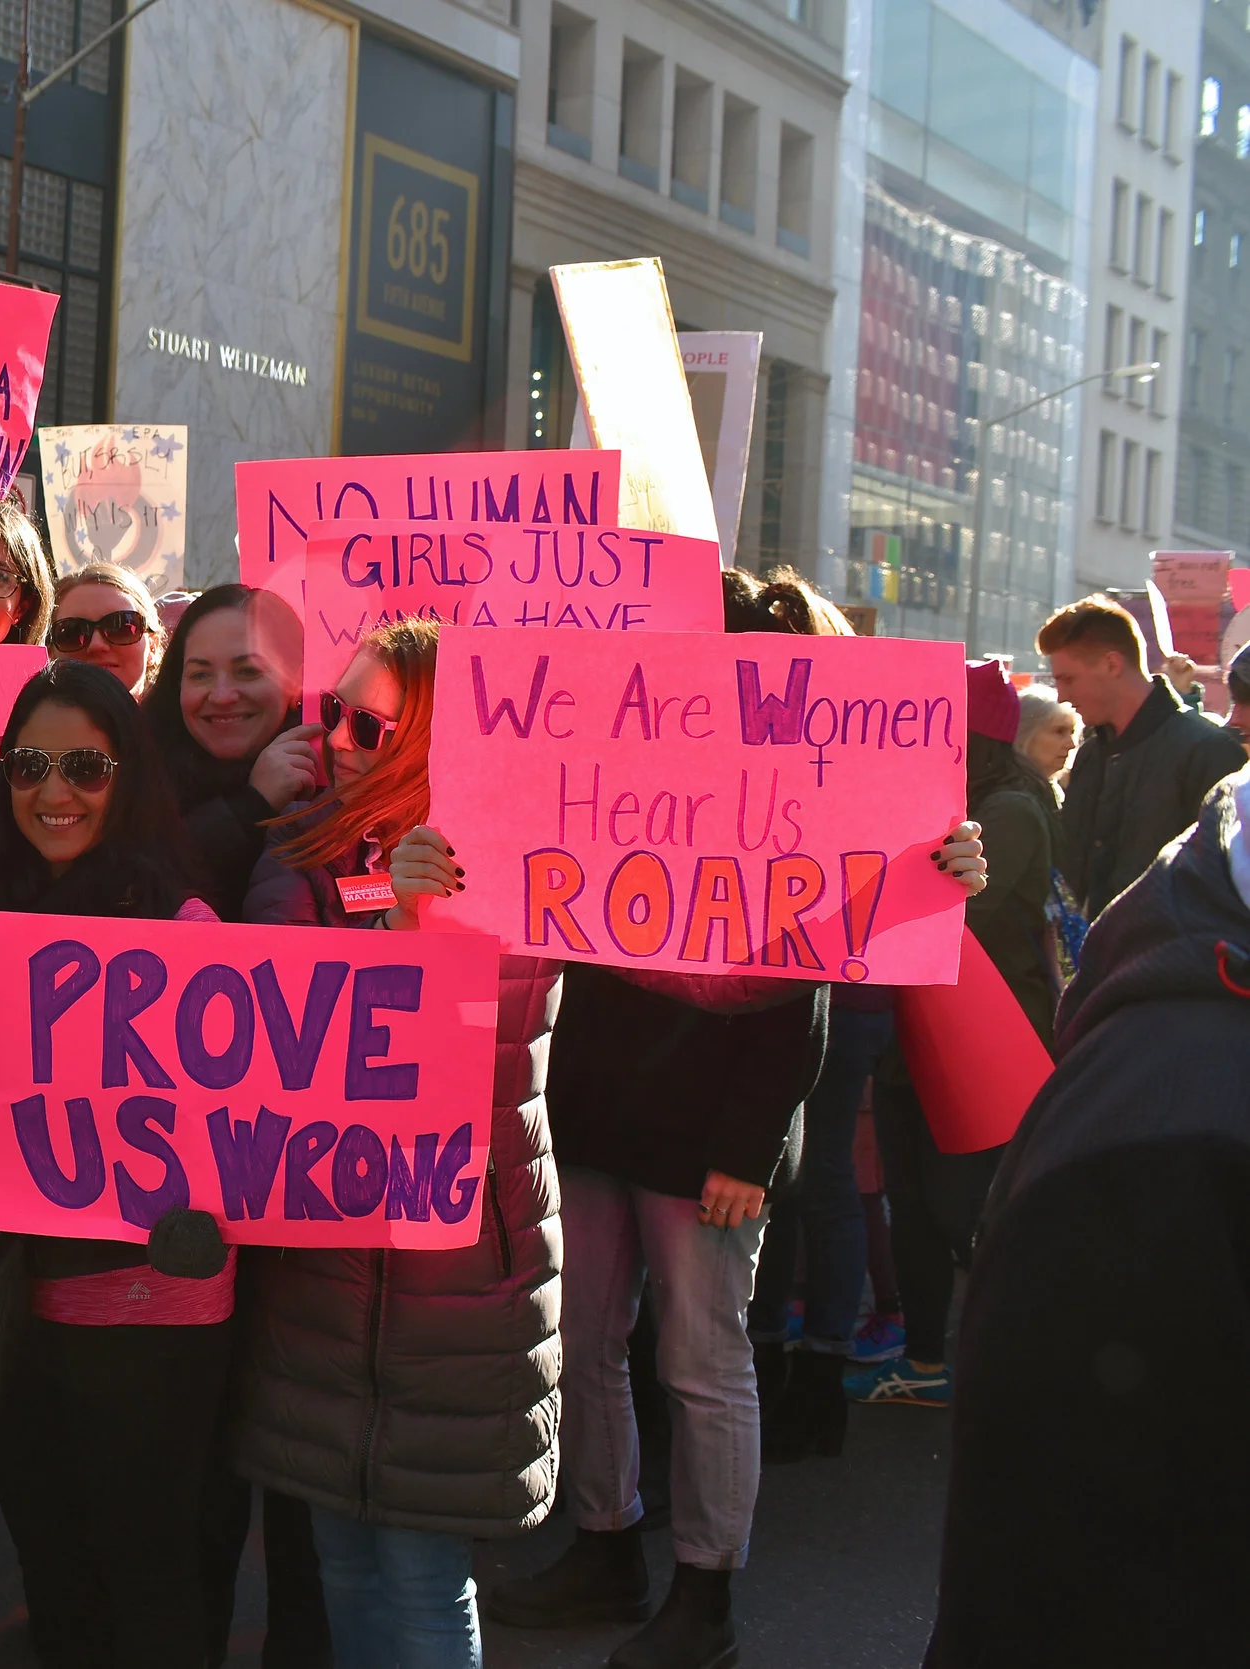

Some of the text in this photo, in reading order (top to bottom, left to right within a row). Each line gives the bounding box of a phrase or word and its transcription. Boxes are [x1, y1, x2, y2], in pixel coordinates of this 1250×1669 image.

[386, 195, 451, 285] 685
[148, 326, 307, 387] STUART WEITZMAN
[681, 352, 729, 365] OPLE
[268, 470, 601, 562] NO HUMAN
[341, 530, 664, 591] GIRLS JUST
[514, 600, 652, 630] HAVE
[470, 654, 963, 788] We Are Women,
[558, 762, 803, 857] Hear Us
[343, 889, 395, 902] MATTERS
[522, 846, 888, 982] ROAR!
[27, 939, 424, 1101] PROVE
[11, 1093, 480, 1230] US WRONG
